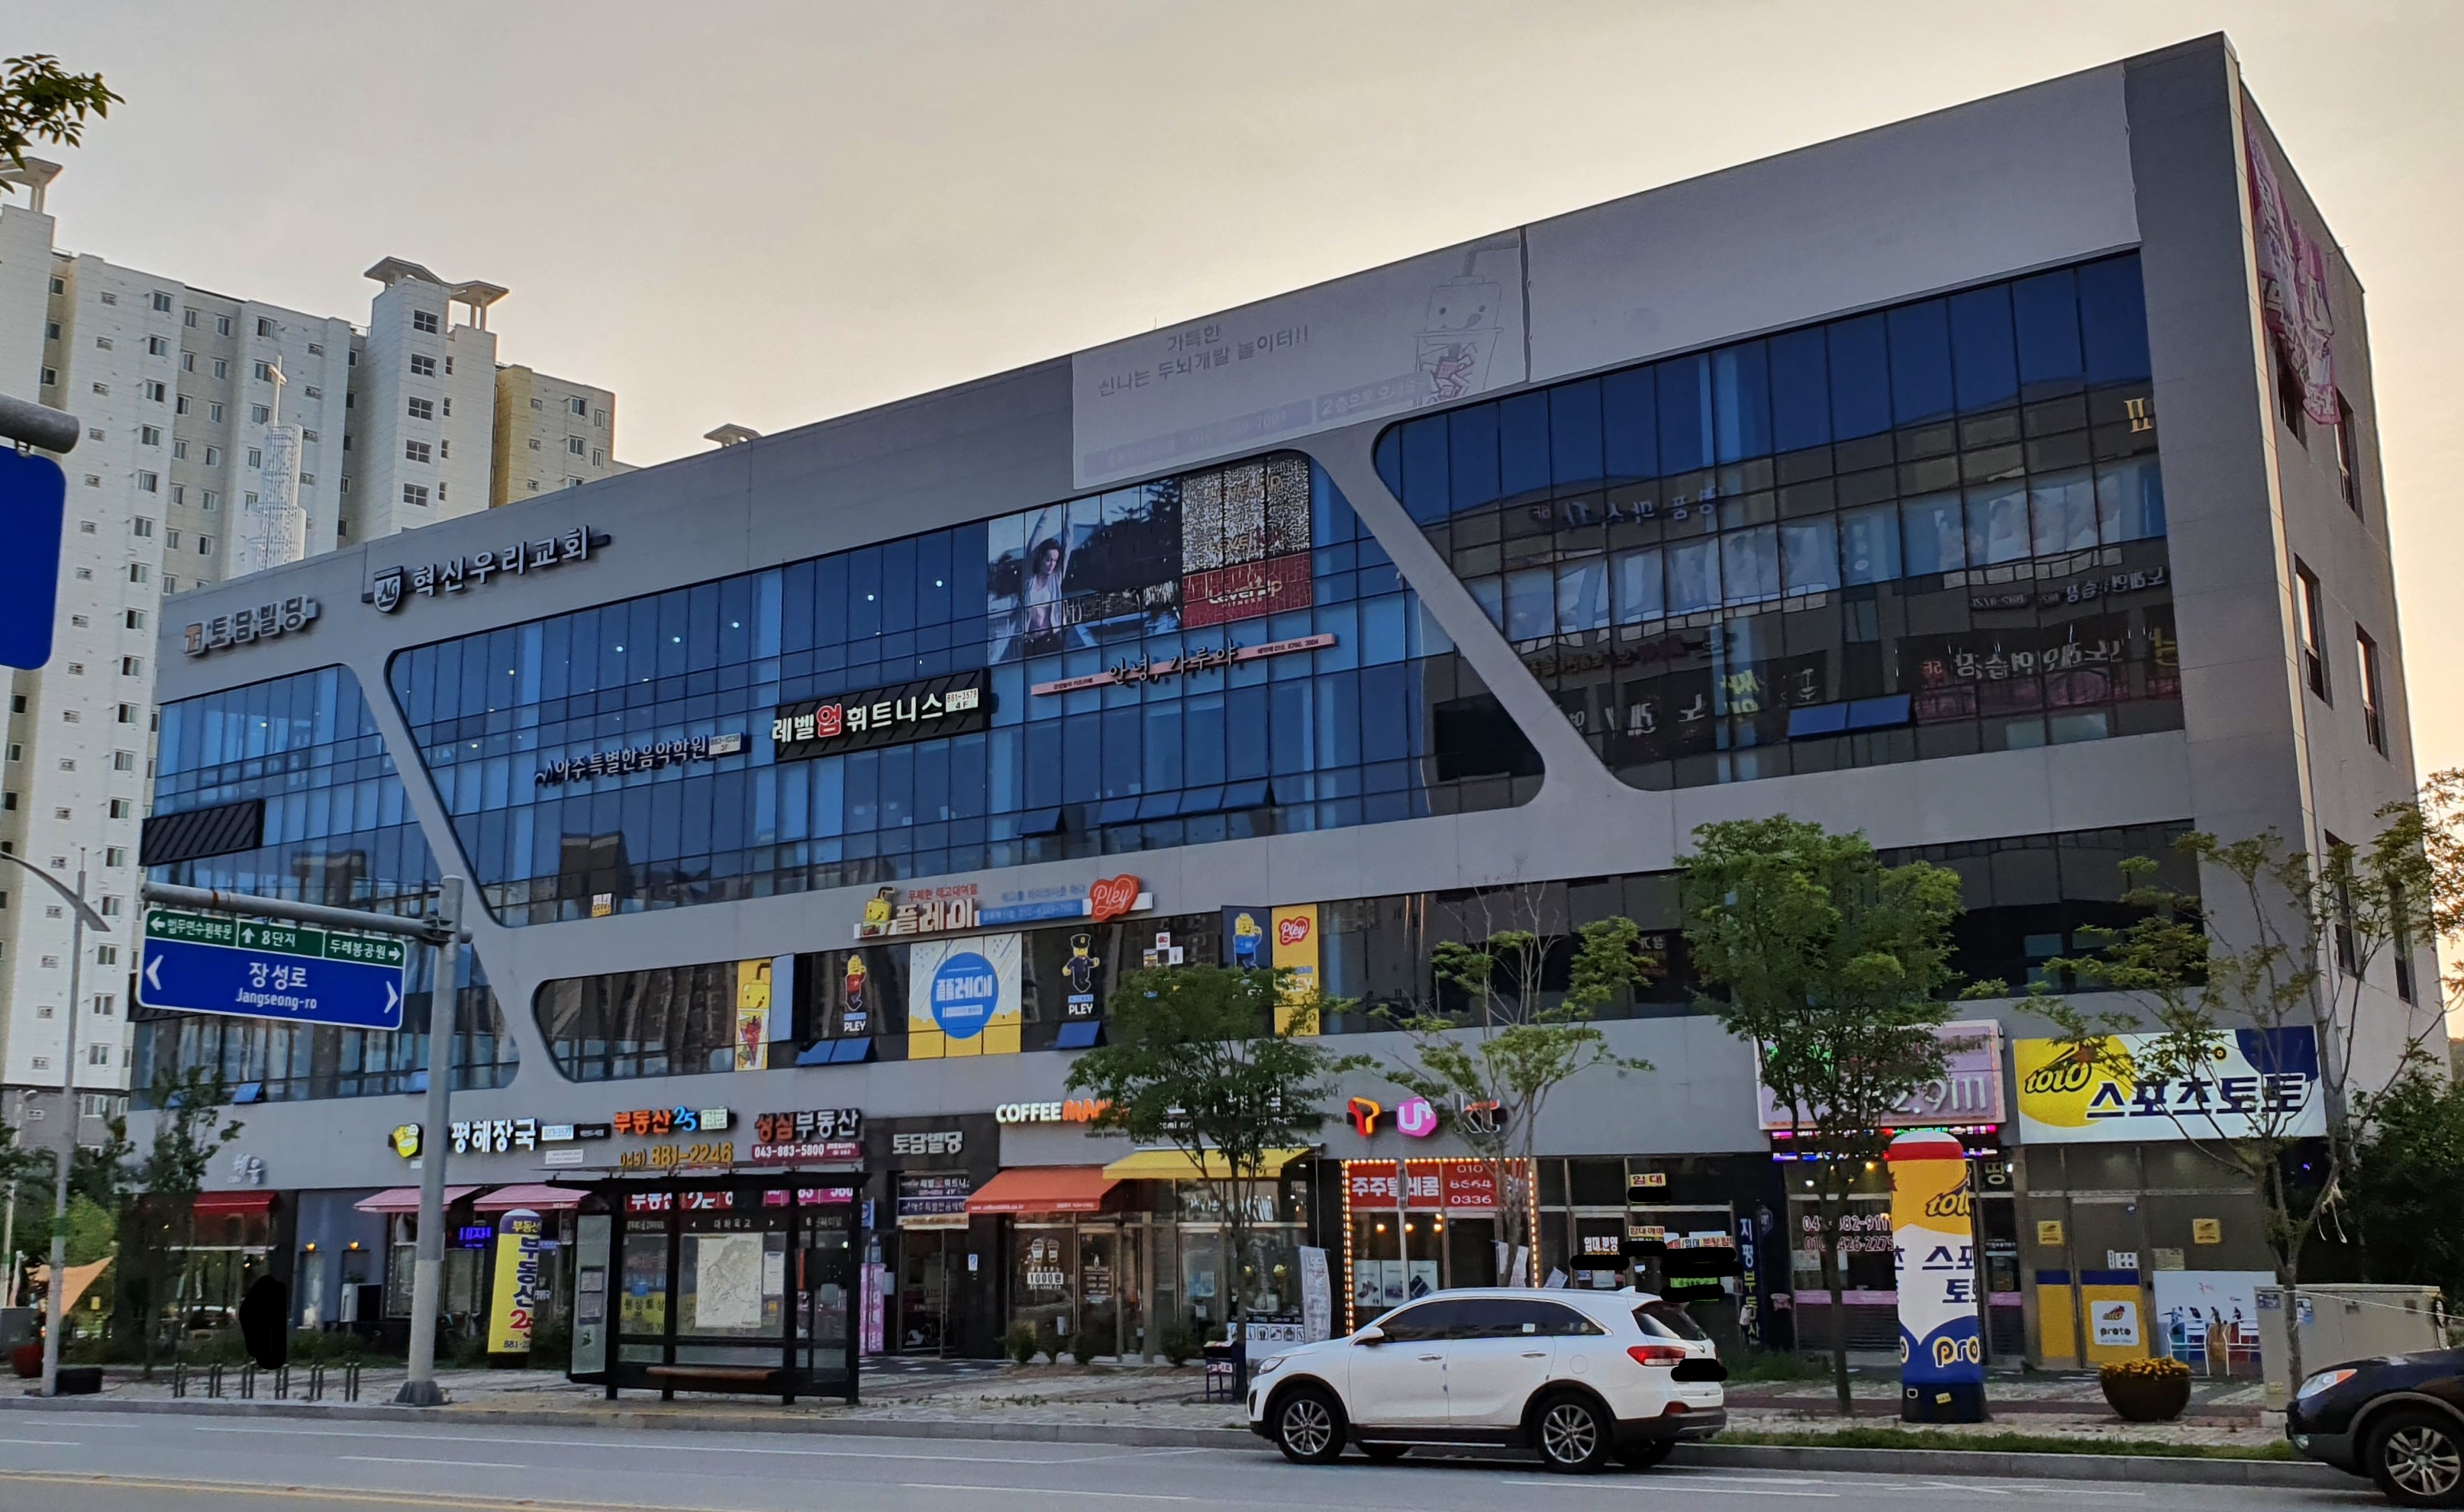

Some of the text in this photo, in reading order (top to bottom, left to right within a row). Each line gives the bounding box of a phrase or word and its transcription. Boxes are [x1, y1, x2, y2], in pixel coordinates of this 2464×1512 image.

[1098, 369, 1150, 397] 신나는
[1158, 347, 1230, 380] 두뇌개발
[413, 525, 590, 597] 혁신우리교회
[209, 595, 305, 649] 토담빌딩
[1108, 638, 1239, 685] 안녕, 가루야
[947, 689, 977, 703] 881-3579
[1093, 886, 1133, 916] Pley
[895, 898, 975, 935] 플레이
[261, 930, 296, 948] 8단지
[1280, 919, 1308, 943] Pley
[329, 939, 386, 959] 두레봉공원
[249, 962, 308, 991] 장성로
[936, 974, 993, 1002] 플레이
[235, 988, 318, 1011] Jangseong-ro
[1068, 1002, 1094, 1016] PLEY
[843, 1020, 866, 1033] PLEY
[2085, 1072, 2308, 1121] 스포츠토토
[995, 1101, 1062, 1124] COFFEE
[451, 1117, 537, 1154] 평해장국
[892, 1130, 963, 1155] 토담빌딩
[651, 1141, 734, 1166] 881-2246
[754, 1143, 824, 1159] 043-883-5800
[1456, 1164, 1484, 1174] 010
[1450, 1194, 1492, 1204] 0336
